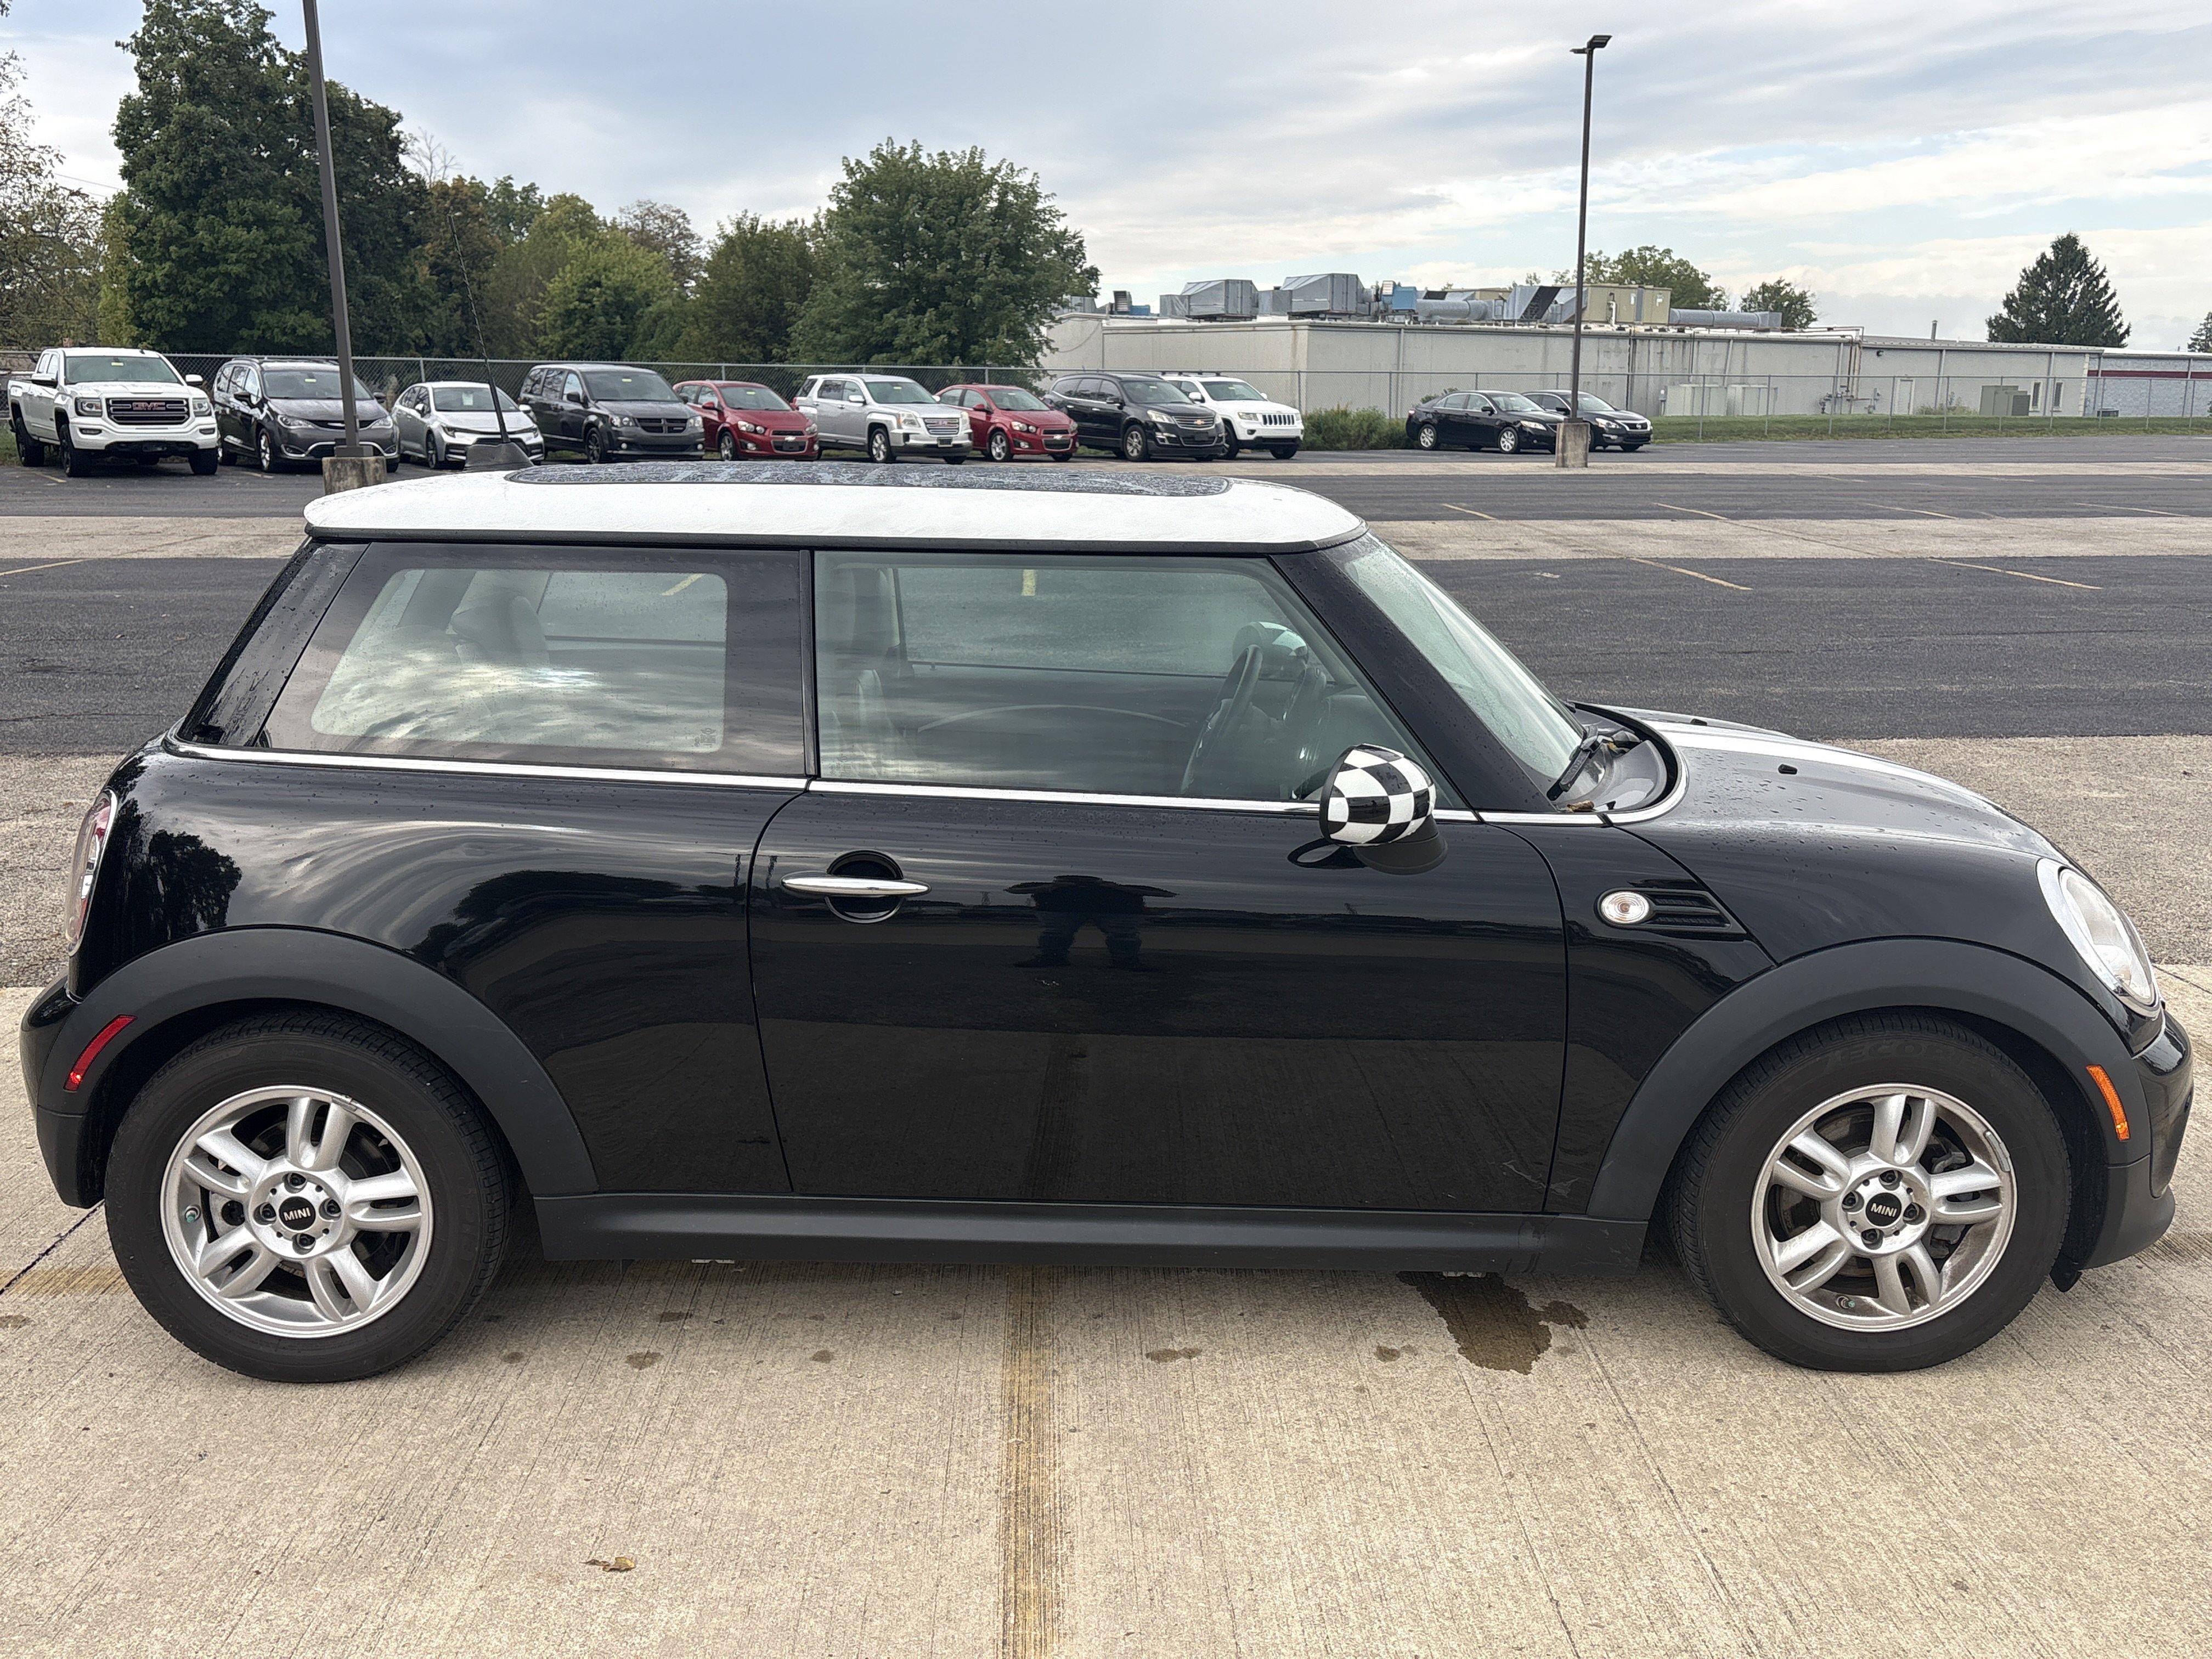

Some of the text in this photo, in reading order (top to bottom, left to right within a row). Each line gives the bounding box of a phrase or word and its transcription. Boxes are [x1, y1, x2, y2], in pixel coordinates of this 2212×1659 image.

[132, 402, 166, 410] GMC
[284, 1207, 311, 1221] MINI
[1871, 1203, 1897, 1217] MINI
